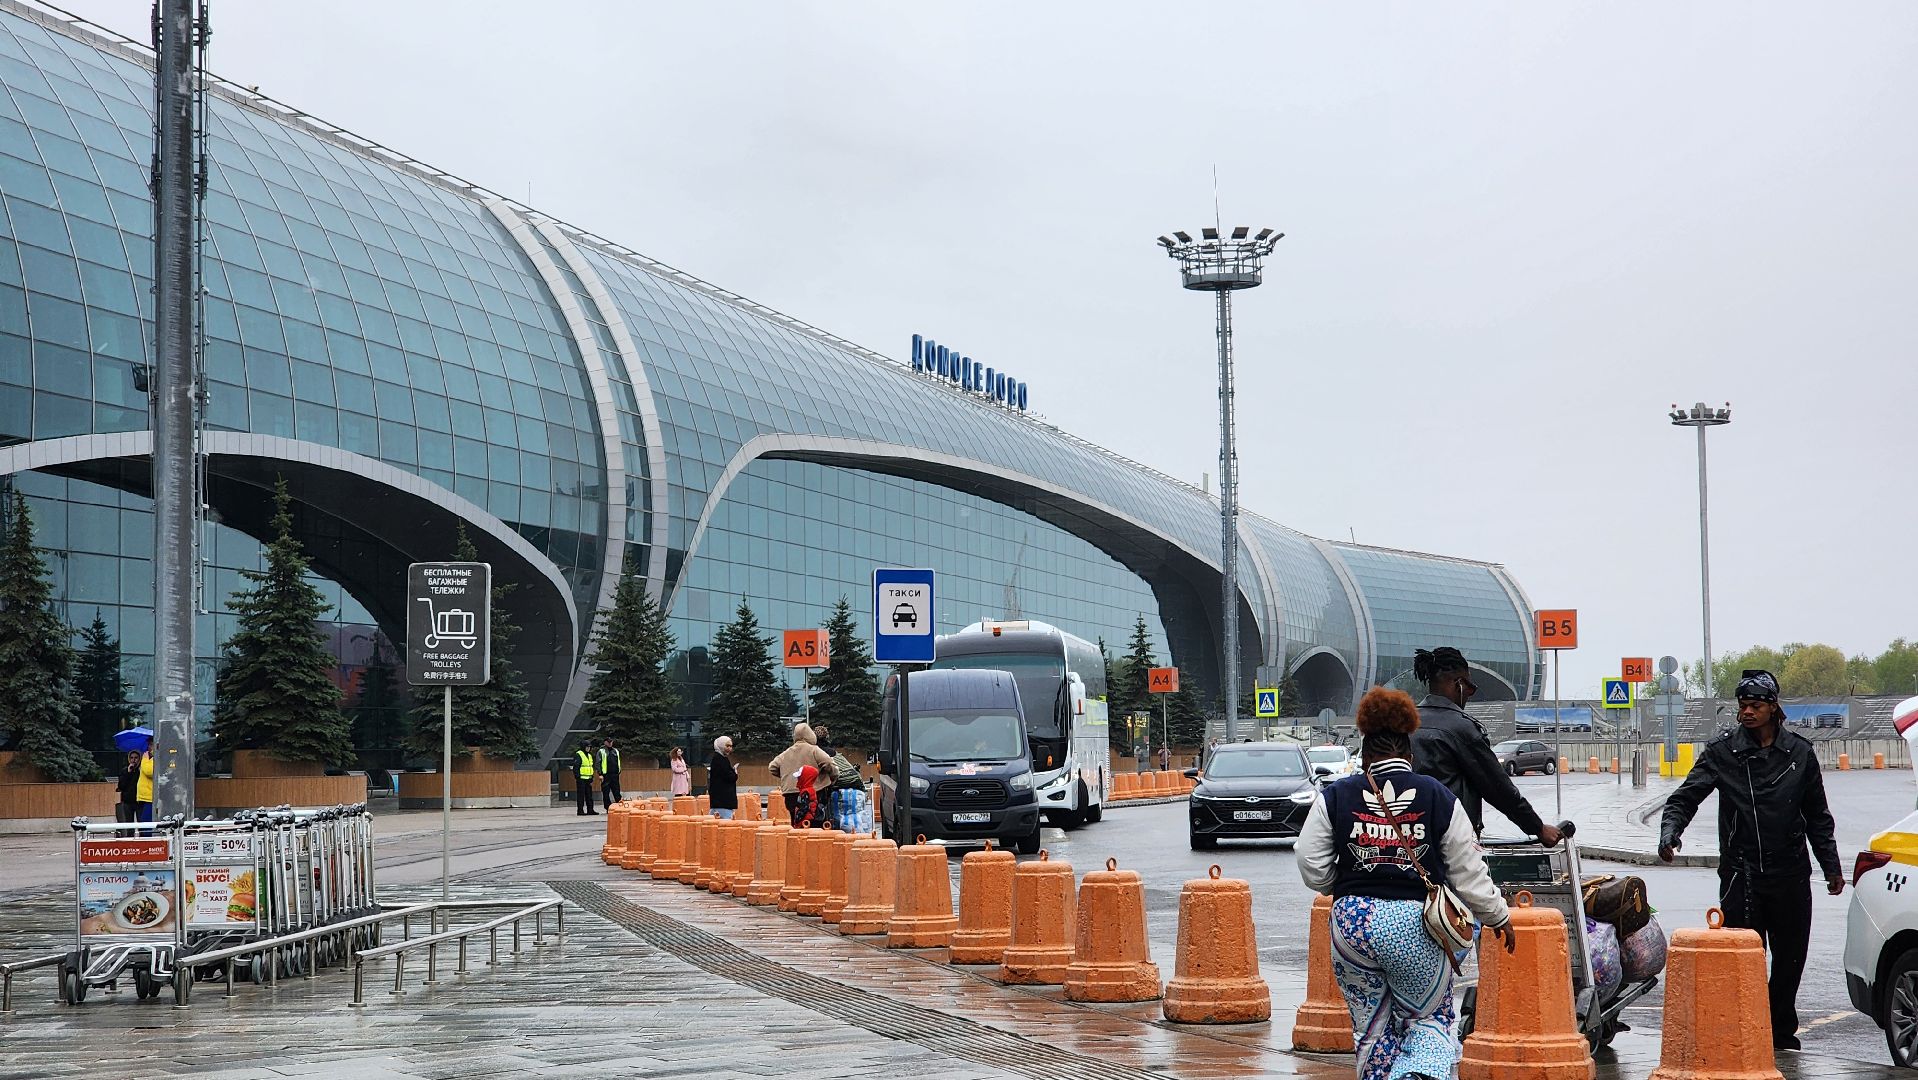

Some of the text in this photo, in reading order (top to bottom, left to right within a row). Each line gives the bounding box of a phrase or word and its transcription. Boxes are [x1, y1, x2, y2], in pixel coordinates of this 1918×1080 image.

[911, 334, 1028, 411] ДОМОДЕДОВО
[423, 568, 473, 577] БЕСПЛАТНЫЕ
[428, 577, 468, 586] БАГАЖНЫЕ
[430, 586, 466, 595] ТЕЛЕЖКИ
[889, 589, 921, 598] такси
[423, 652, 439, 660] FREE
[430, 660, 462, 668] TROLLEYS
[88, 848, 121, 857] ПАТИО
[97, 876, 129, 885] ПАТИО
[196, 874, 230, 883] ВКУС!
